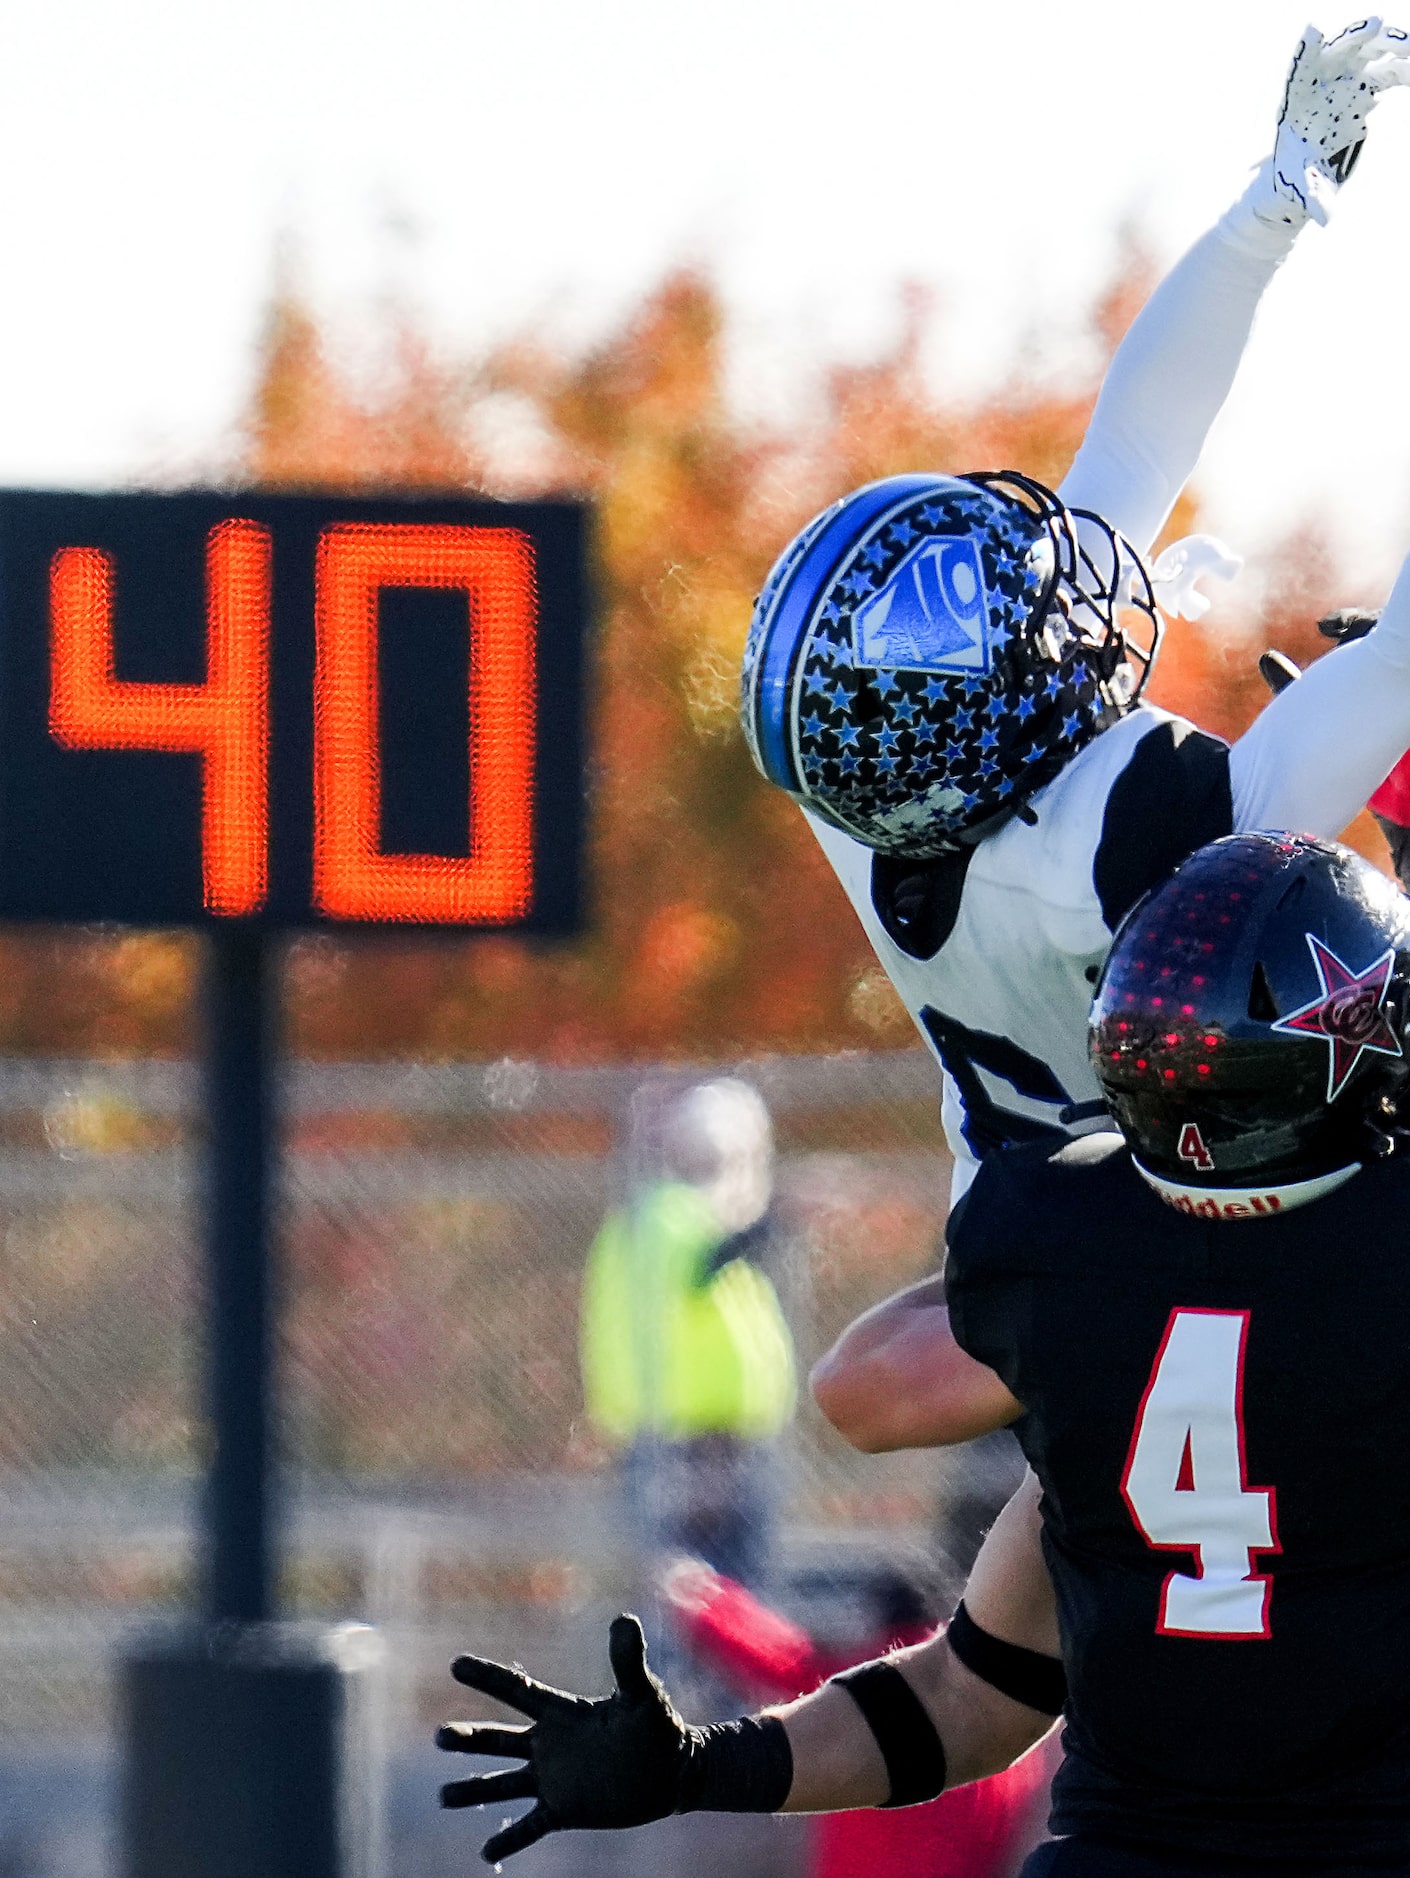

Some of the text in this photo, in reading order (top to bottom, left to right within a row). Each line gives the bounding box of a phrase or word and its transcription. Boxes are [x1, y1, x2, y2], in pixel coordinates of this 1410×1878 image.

[49, 517, 538, 923] 40
[1177, 1123, 1215, 1171] 4
[1119, 1306, 1284, 1640] 4
